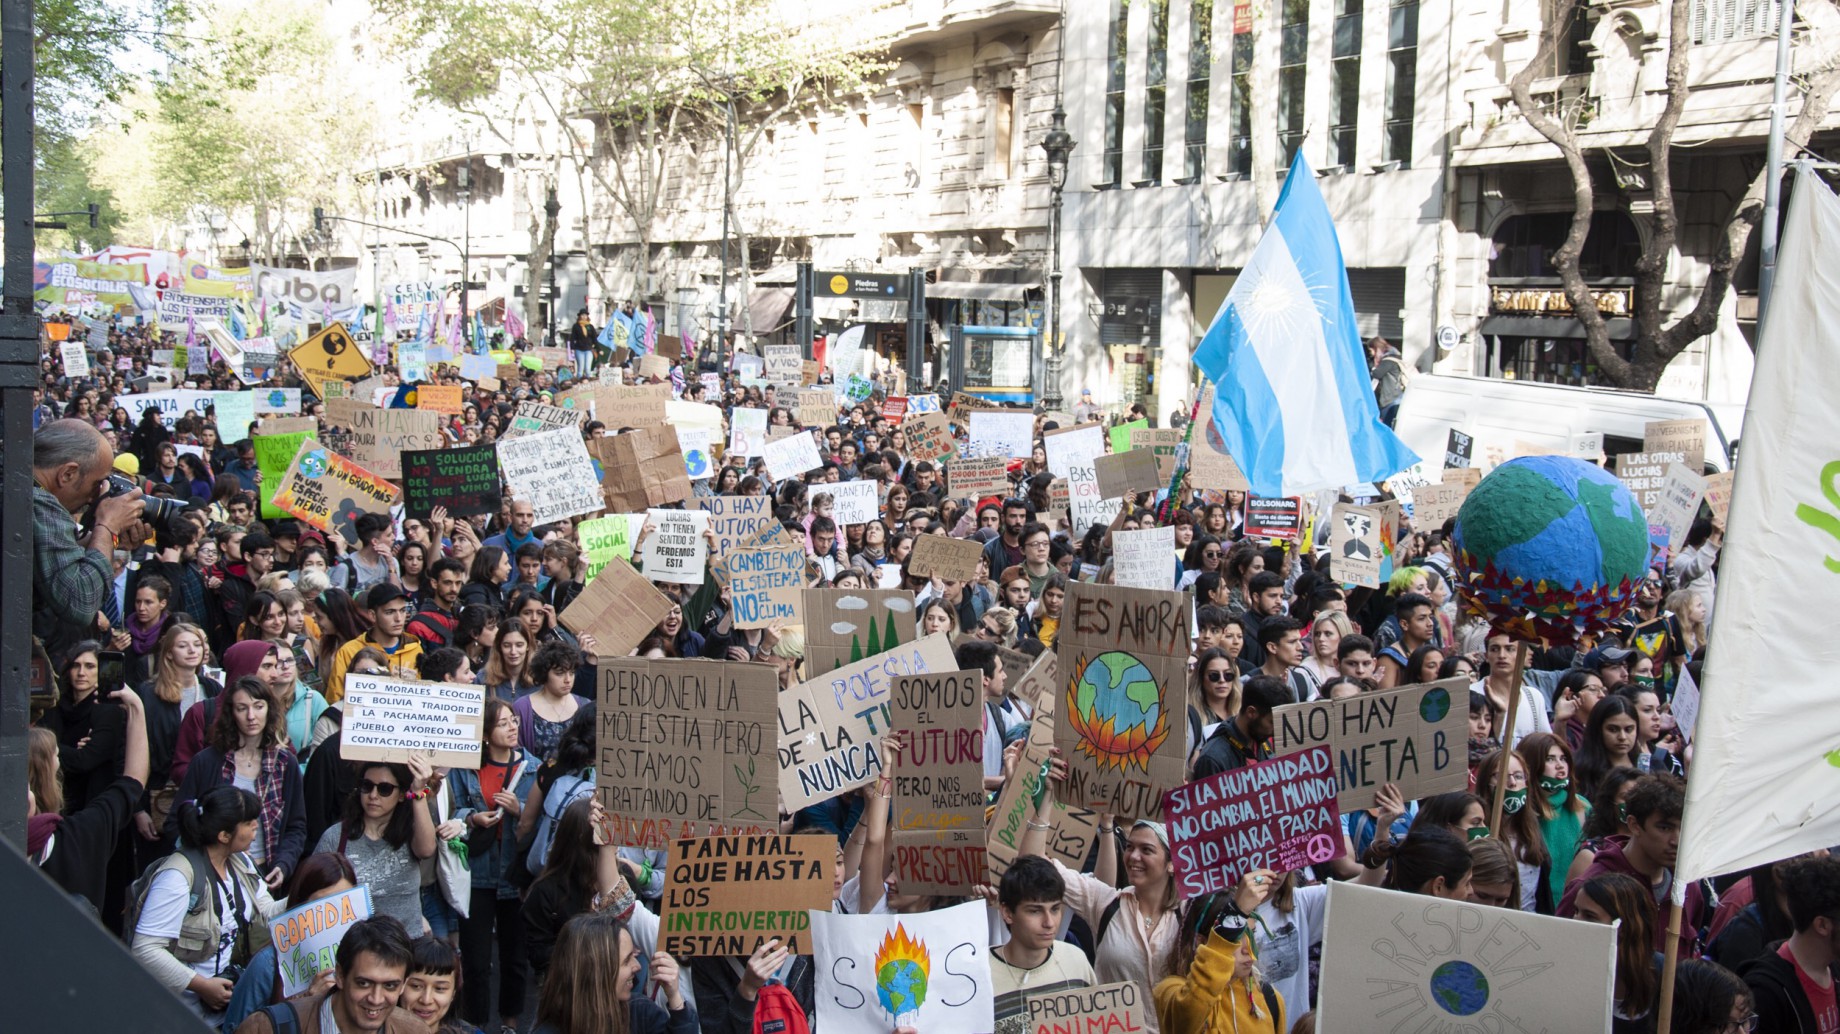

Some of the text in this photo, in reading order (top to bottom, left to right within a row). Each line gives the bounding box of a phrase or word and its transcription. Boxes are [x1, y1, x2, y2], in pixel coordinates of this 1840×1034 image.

[52, 263, 77, 276] RED
[163, 291, 177, 301] EN
[176, 293, 217, 306] DEFENSA
[1497, 291, 1550, 311] SAINT
[161, 302, 180, 314] LOS
[325, 381, 343, 390] ESTE
[776, 391, 799, 400] CAPITAL
[136, 398, 177, 413] SANTA
[518, 401, 580, 426] SE LE LLAMA
[353, 410, 374, 429] UN
[377, 410, 437, 434] PLASTICO
[904, 421, 928, 437] OUR
[354, 432, 376, 446] DURA
[908, 425, 943, 448] HOUSE
[1132, 431, 1151, 443] NO
[1453, 431, 1470, 446] THIS
[1668, 438, 1704, 452] PLANETA
[412, 455, 427, 465] LA
[435, 447, 494, 466] SOLUCIÓN
[1457, 445, 1465, 455] IS
[1627, 452, 1685, 465] LAS OTRAS
[408, 471, 498, 487] DEL LUGAR
[411, 463, 490, 477] NO VENDRA
[1622, 466, 1662, 478] LUCHAS
[304, 479, 323, 492] UNA
[336, 470, 348, 482] UN
[347, 474, 374, 494] GRADO
[371, 488, 393, 504] MÁS
[409, 487, 453, 498] DEL QUE
[833, 484, 876, 498] PLANETA
[294, 496, 329, 517] MENOS
[413, 500, 430, 511] LA
[699, 497, 765, 515] NO HAY
[841, 500, 856, 510] HAY
[1251, 499, 1297, 508] BOLSONARO:
[581, 515, 624, 536] CAMBIO
[665, 512, 691, 522] LUCHAS
[660, 523, 696, 534] NO TIENEN
[585, 532, 627, 551] SOCIAL
[659, 534, 696, 545] SENTIDO SI
[656, 545, 696, 557] PERDEMOS
[665, 558, 683, 568] ESTA
[729, 549, 806, 573] CAMBIEMOS
[732, 570, 802, 592] EL SISTEMA
[732, 591, 772, 624] NO EL
[758, 604, 796, 619] CLIMA
[1075, 599, 1192, 650] ES AHORA
[355, 681, 482, 701] EVO MORALES ECOCIDA
[605, 669, 740, 712] PERDONEN LA
[899, 676, 976, 710] SOMOS
[349, 695, 480, 715] DE BOLIVIA TRAIDOR DE
[362, 708, 449, 723] LA PACHAMAMA
[778, 698, 817, 736] LA
[916, 711, 935, 724] EL
[1282, 695, 1399, 749] NO HAY
[352, 722, 462, 736] ¡PUEBLO AYOREO NO
[602, 711, 762, 756] MOLESTIA PERO
[351, 735, 421, 748] CONTACTADO
[422, 740, 436, 749] EN
[777, 725, 853, 770] DE LA
[897, 728, 984, 768] FUTURO
[1433, 730, 1450, 772] B
[601, 747, 702, 789] ESTAMOS
[797, 741, 884, 798] NUNCA
[896, 776, 960, 797] PERO NOS
[1090, 782, 1108, 799] QUE
[1170, 748, 1331, 815] SI LA HUMANIDAD
[600, 786, 720, 820] TRATANDO DE
[931, 792, 983, 809] HACEMOS
[1172, 775, 1338, 843] NO CAMBIA, EL MUNDO
[600, 812, 673, 848] SALVAR
[899, 808, 971, 841] Cargo
[953, 830, 968, 841] DEL
[1177, 845, 1199, 873] SI
[1201, 839, 1221, 866] LO
[1278, 806, 1334, 840] PARA
[1279, 832, 1315, 850] RESPECT
[677, 835, 803, 860] TAN MAL,
[1279, 848, 1298, 859] YOUR
[899, 845, 992, 886] PRESENTE
[1281, 850, 1307, 866] MOTHER
[1285, 858, 1309, 871] EARTH
[673, 860, 823, 884] QUE HASTA
[1183, 848, 1282, 900] SIEMPRE
[669, 887, 710, 908] LOS
[665, 932, 745, 956] ESTÁN
[1371, 902, 1556, 992] RESPETA
[1029, 983, 1136, 1022] PRODUCTO
